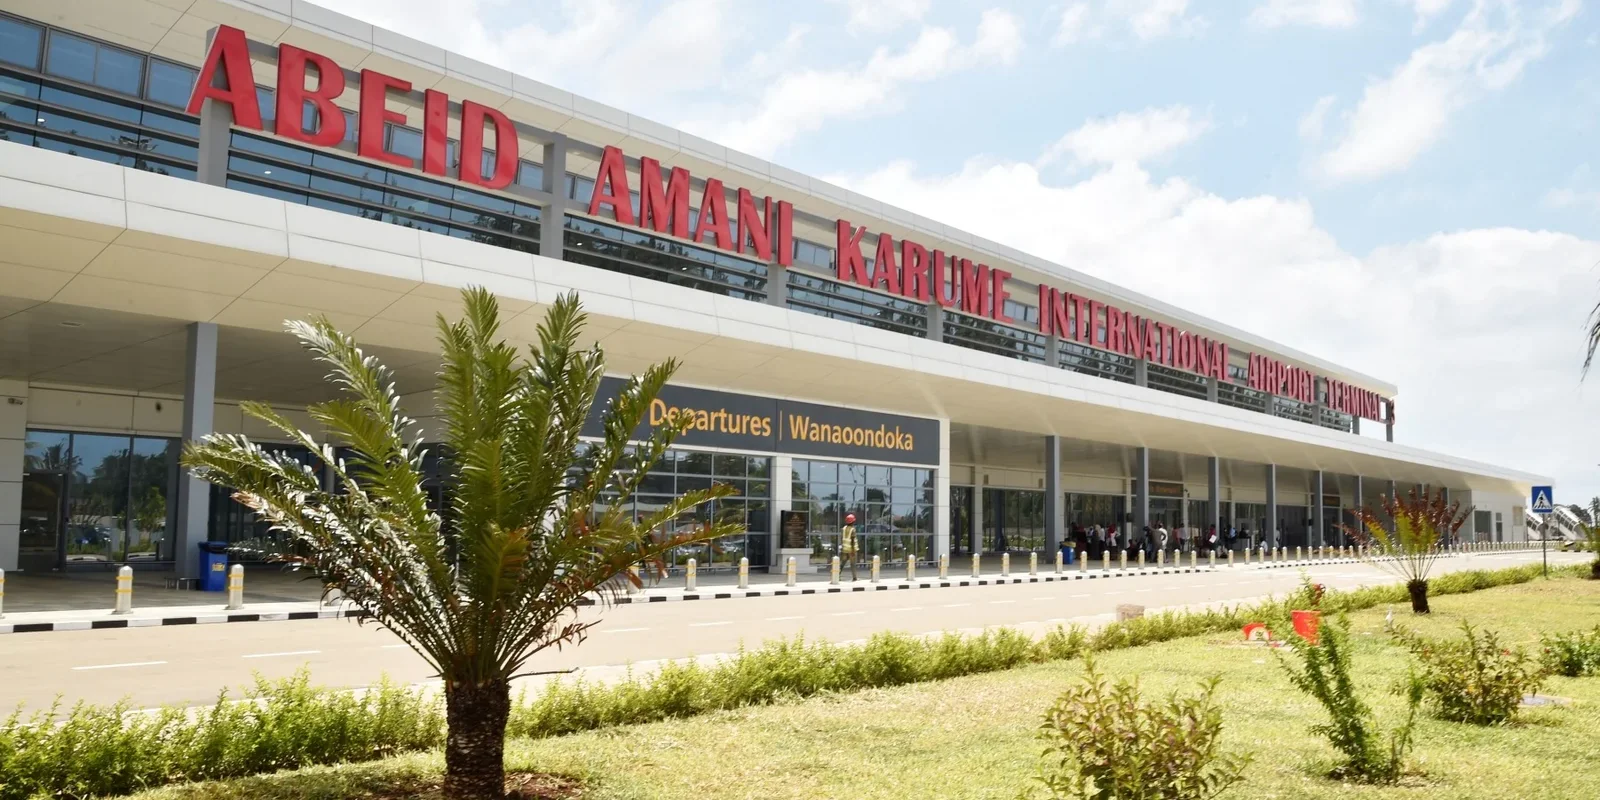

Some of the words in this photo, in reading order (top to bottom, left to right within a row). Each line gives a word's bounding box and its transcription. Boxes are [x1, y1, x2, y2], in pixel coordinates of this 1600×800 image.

[186, 24, 518, 190] ABEID
[587, 145, 793, 267] AMANI
[836, 219, 1012, 324] KARUME
[1038, 284, 1234, 384] INTERNATIONAL
[1247, 352, 1316, 403] AIRPORT
[1324, 377, 1385, 422] TERMINAL
[789, 413, 914, 451] Wanaoondoka
